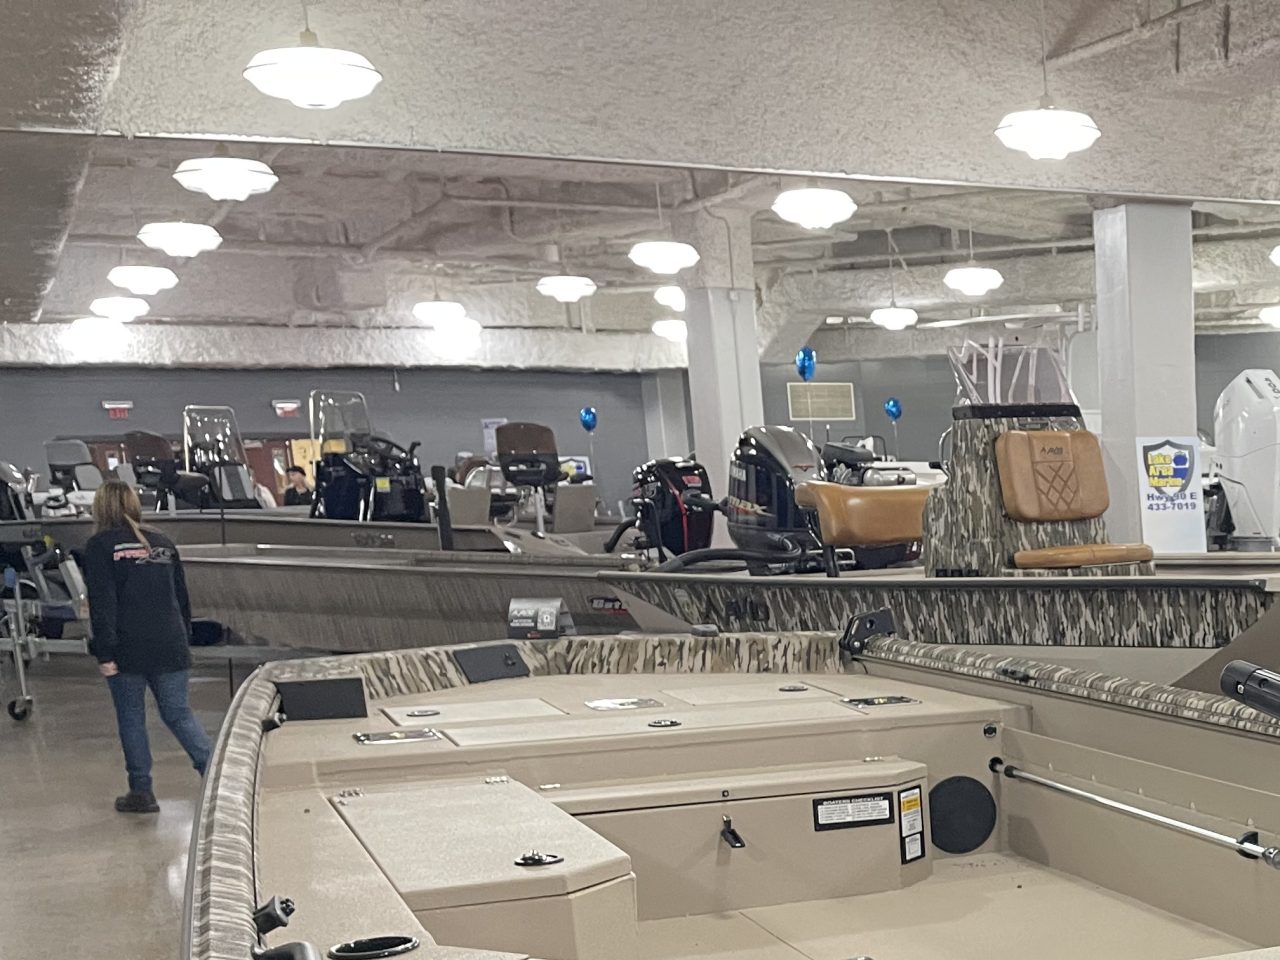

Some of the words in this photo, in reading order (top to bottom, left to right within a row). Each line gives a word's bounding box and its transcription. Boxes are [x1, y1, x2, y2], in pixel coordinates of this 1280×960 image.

[1148, 452, 1172, 465] Lake
[1149, 466, 1174, 476] Area
[1149, 476, 1185, 488] Marine
[1147, 493, 1169, 503] Hwy
[1190, 492, 1197, 500] E
[1147, 502, 1197, 511] 433-7019
